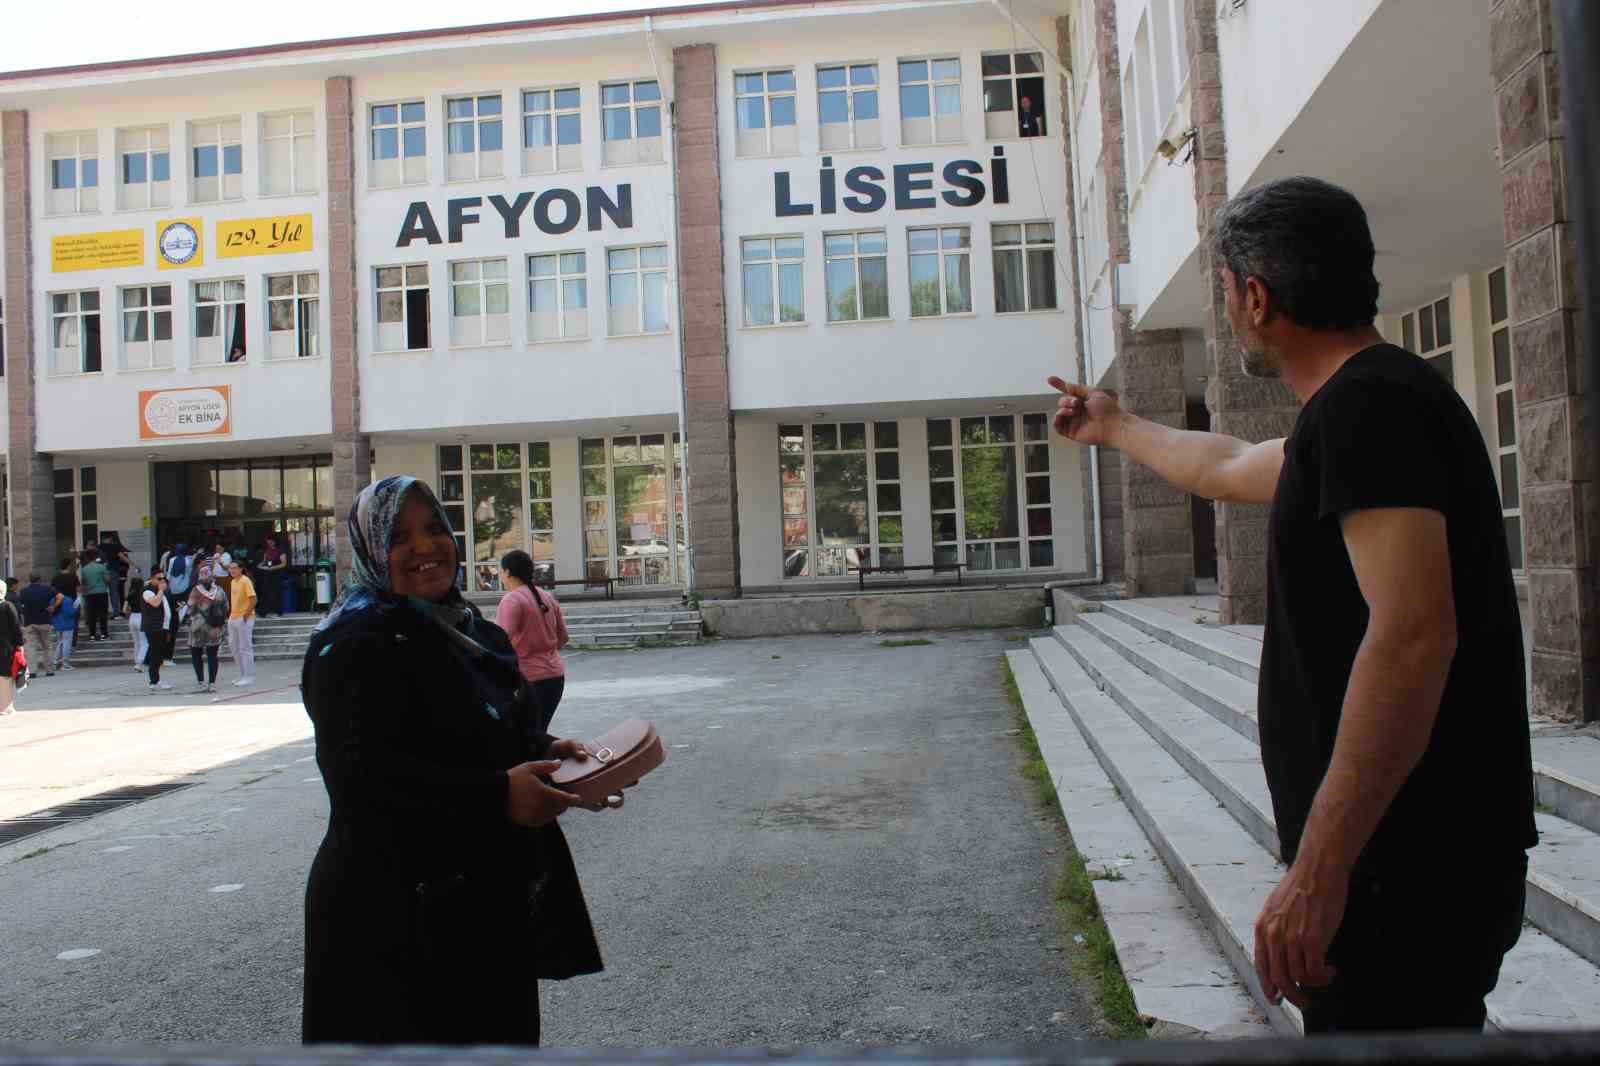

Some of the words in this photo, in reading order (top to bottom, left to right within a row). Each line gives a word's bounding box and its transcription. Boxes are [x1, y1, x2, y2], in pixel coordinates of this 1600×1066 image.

[395, 183, 634, 248] AFYON
[773, 145, 1010, 218] LİSESİ
[225, 228, 260, 247] 129.
[178, 413, 193, 425] EK
[195, 411, 222, 424] BİNA
